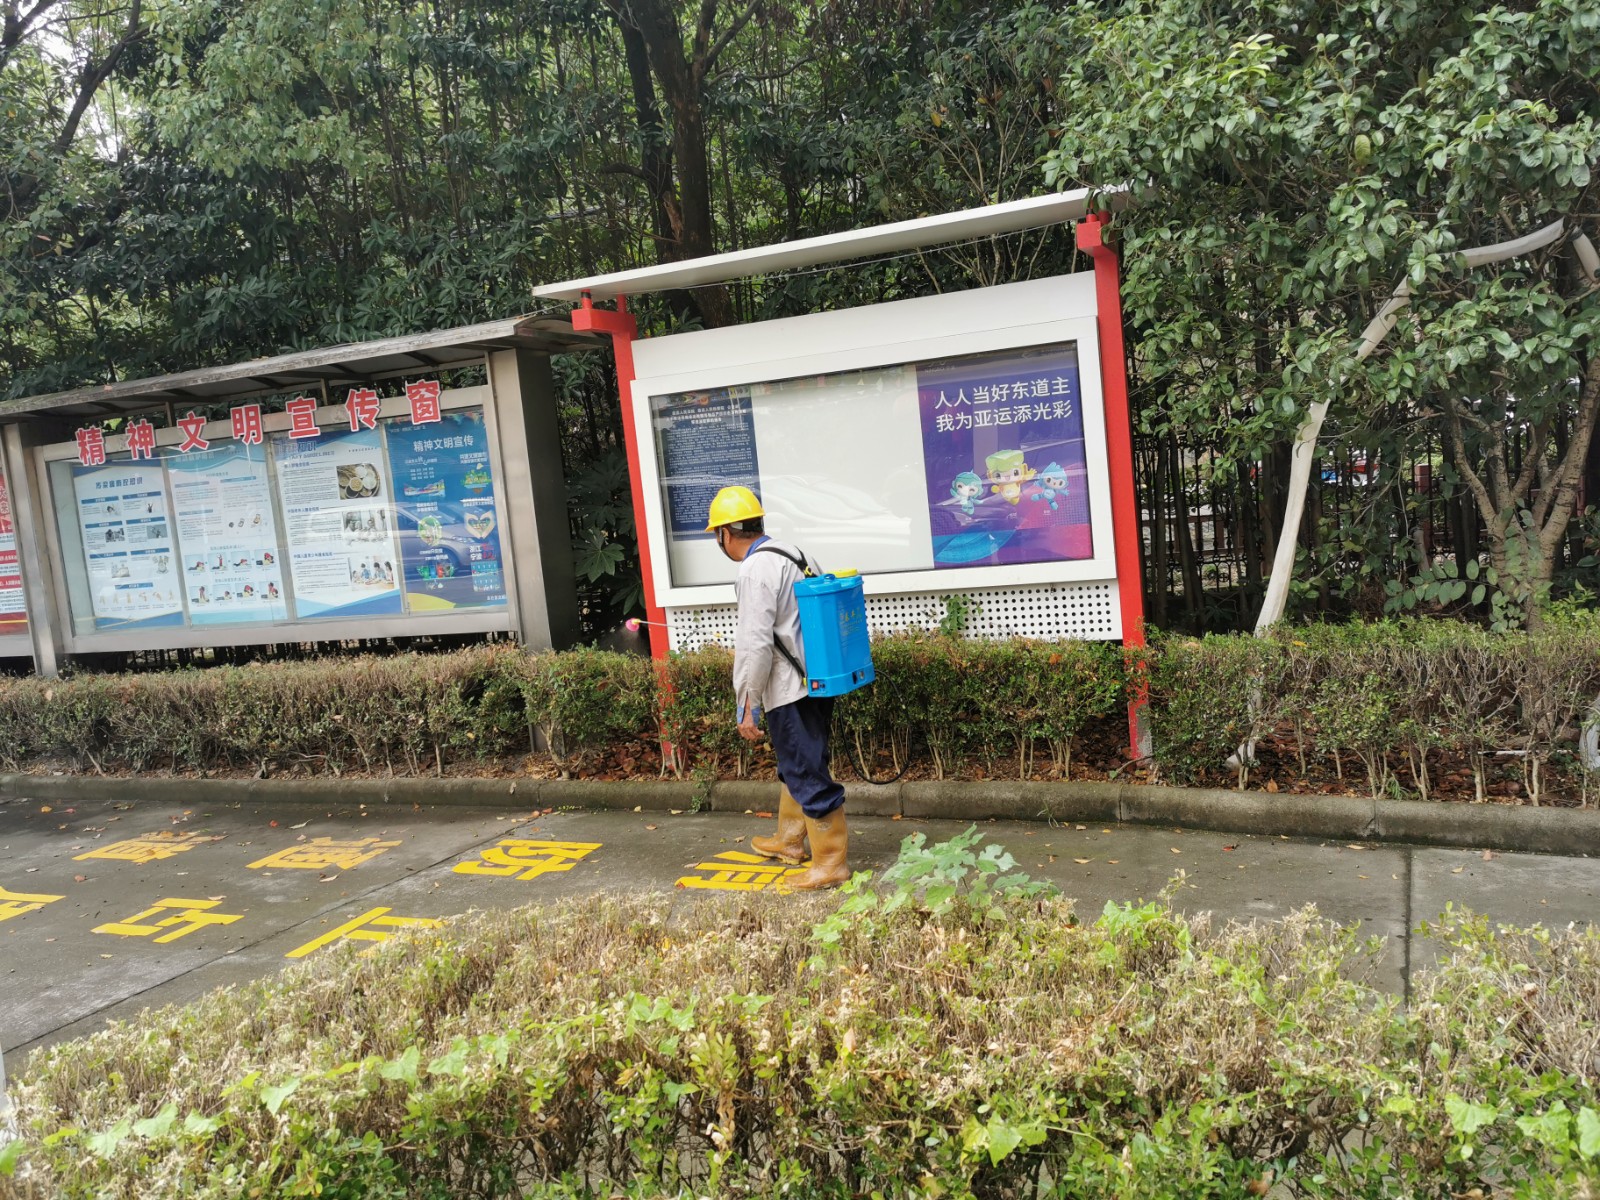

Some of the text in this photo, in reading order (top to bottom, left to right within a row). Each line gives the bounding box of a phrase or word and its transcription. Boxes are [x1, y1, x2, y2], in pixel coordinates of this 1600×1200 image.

[934, 376, 1071, 411] 人人当好东道主
[74, 379, 442, 467] 精神文明宣传窗
[935, 399, 1073, 433] 我为亚运添光彩
[413, 434, 474, 453] 精神文明宣传
